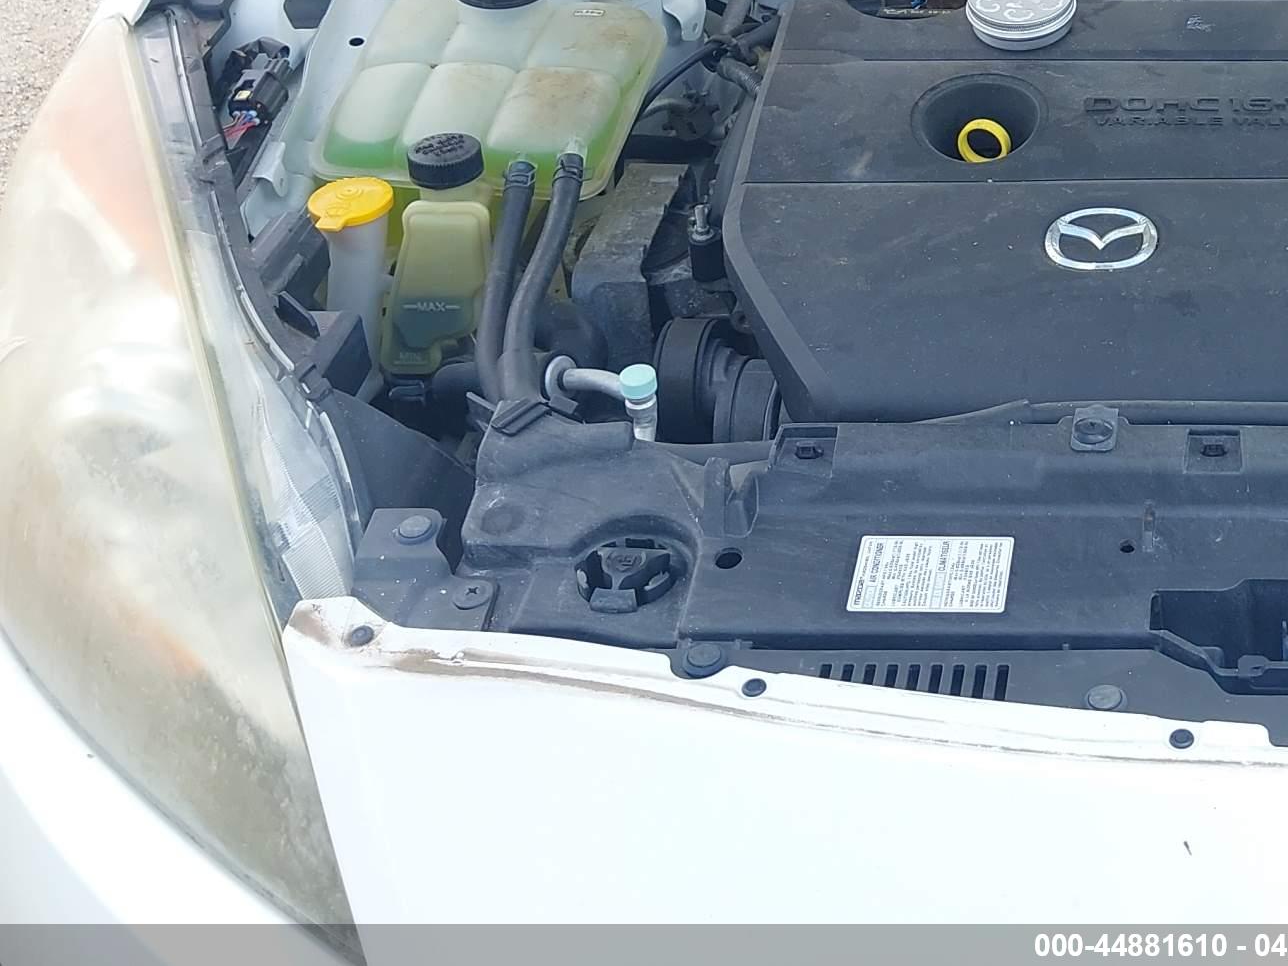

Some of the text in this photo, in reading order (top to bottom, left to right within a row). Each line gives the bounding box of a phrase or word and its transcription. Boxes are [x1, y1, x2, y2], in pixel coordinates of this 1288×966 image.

[1084, 97, 1220, 113] DOHC
[1095, 116, 1224, 127] VARIABLE
[416, 301, 446, 312] MAX
